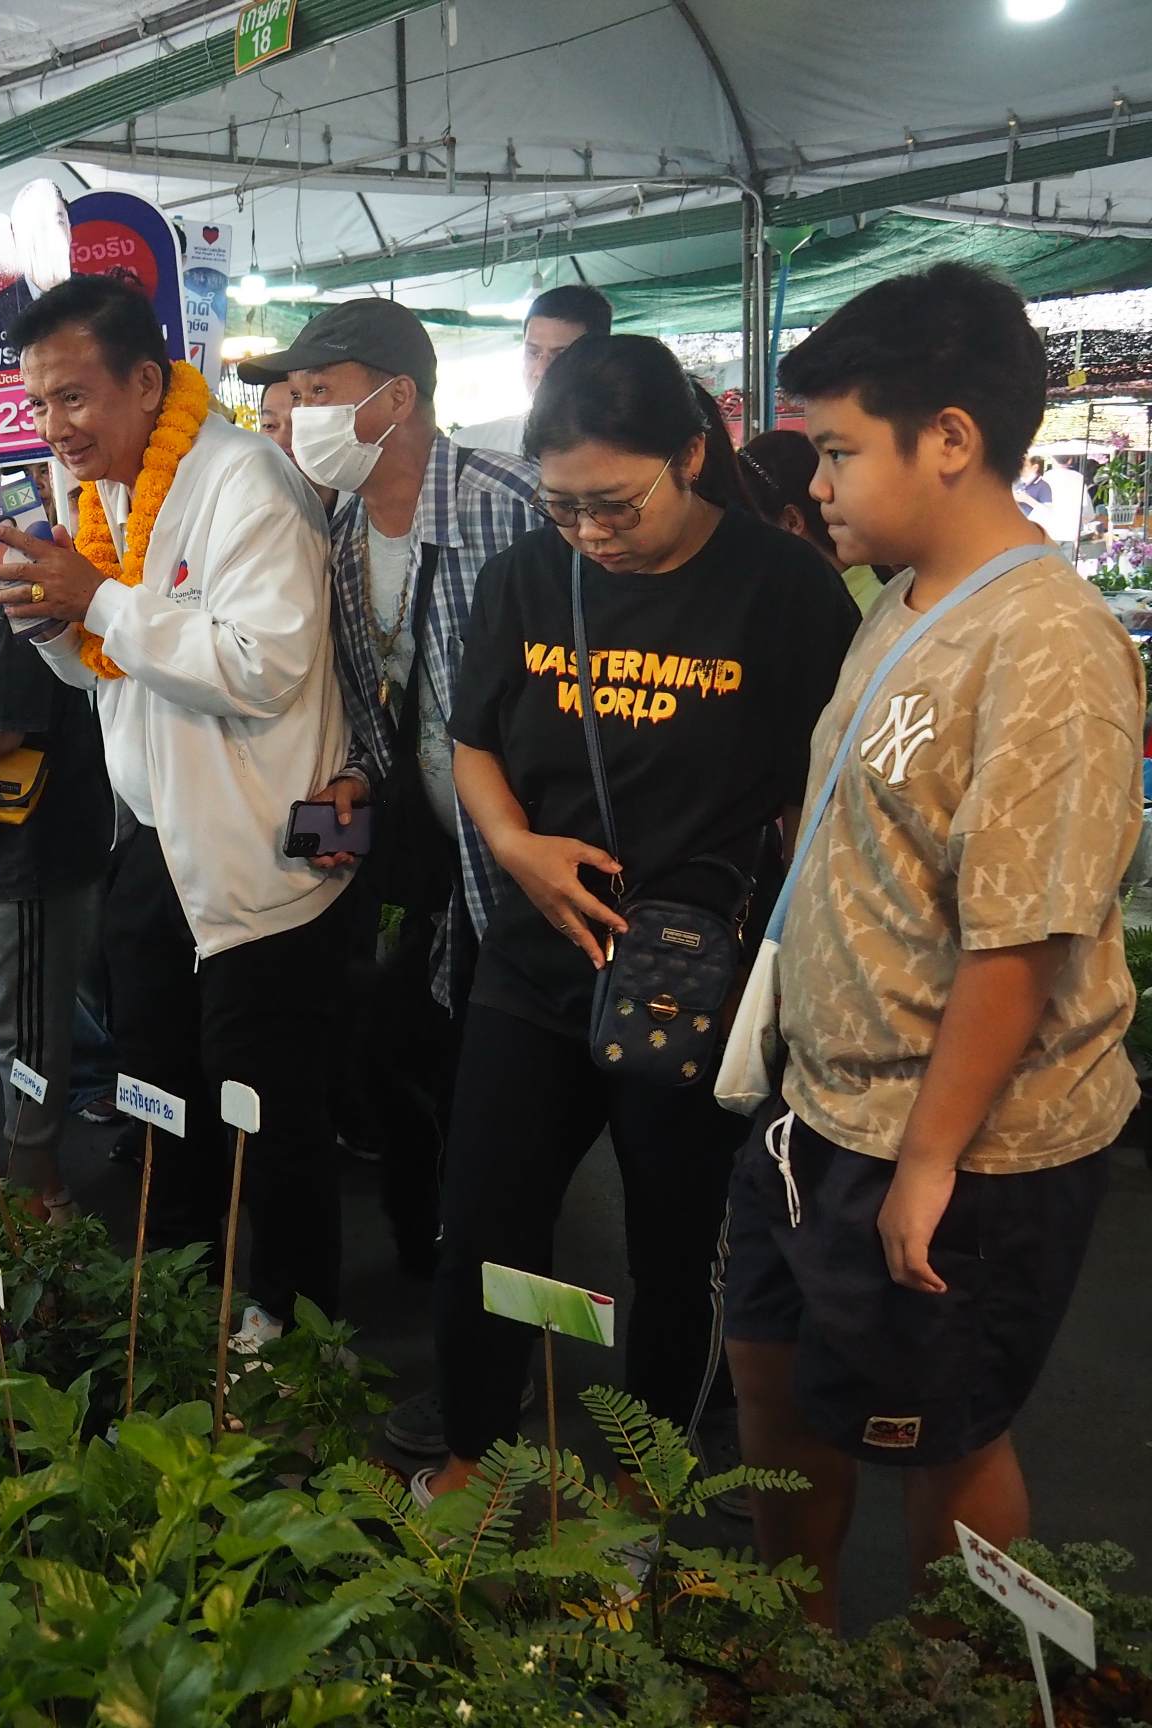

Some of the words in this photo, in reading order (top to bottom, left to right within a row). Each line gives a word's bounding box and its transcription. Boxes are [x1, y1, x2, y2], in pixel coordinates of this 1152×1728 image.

[252, 26, 271, 57] 18
[558, 681, 677, 729] WORLD
[163, 1103, 174, 1120] 20
